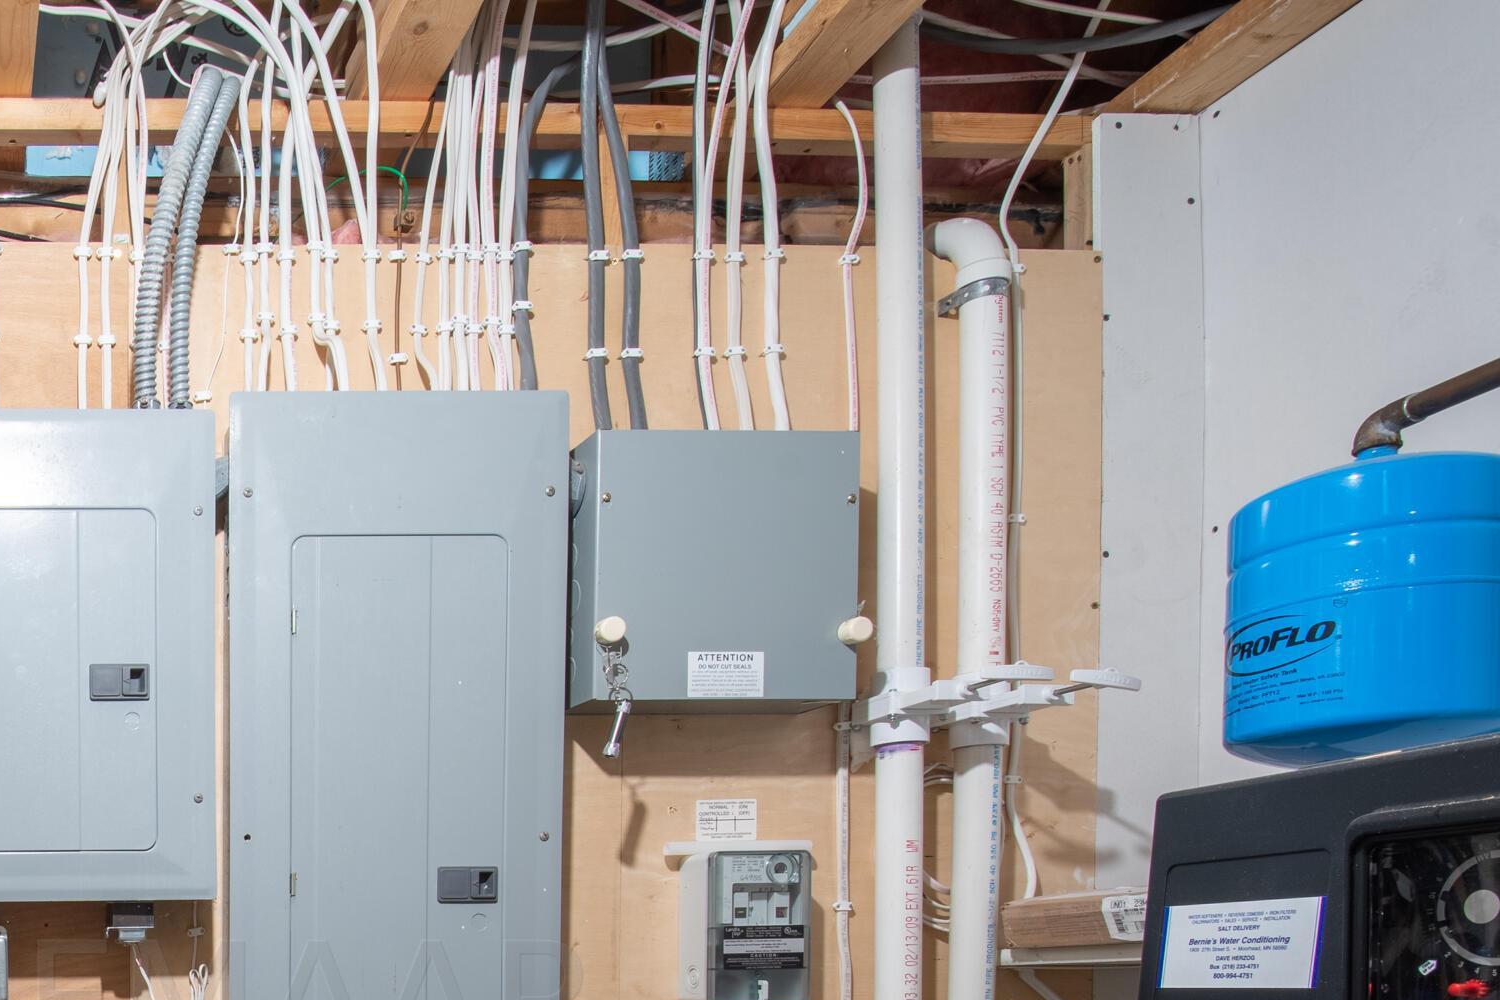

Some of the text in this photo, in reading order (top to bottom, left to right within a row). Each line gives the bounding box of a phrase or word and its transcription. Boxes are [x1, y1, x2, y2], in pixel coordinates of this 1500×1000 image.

[991, 406, 1005, 426] PVC
[991, 432, 1005, 457] TYPE
[991, 502, 1005, 515] 40
[991, 521, 1005, 548] ASTM
[986, 924, 994, 964] PRODUCTS
[1189, 937, 1216, 946] Bernie's
[1241, 936, 1290, 944] Conditioning
